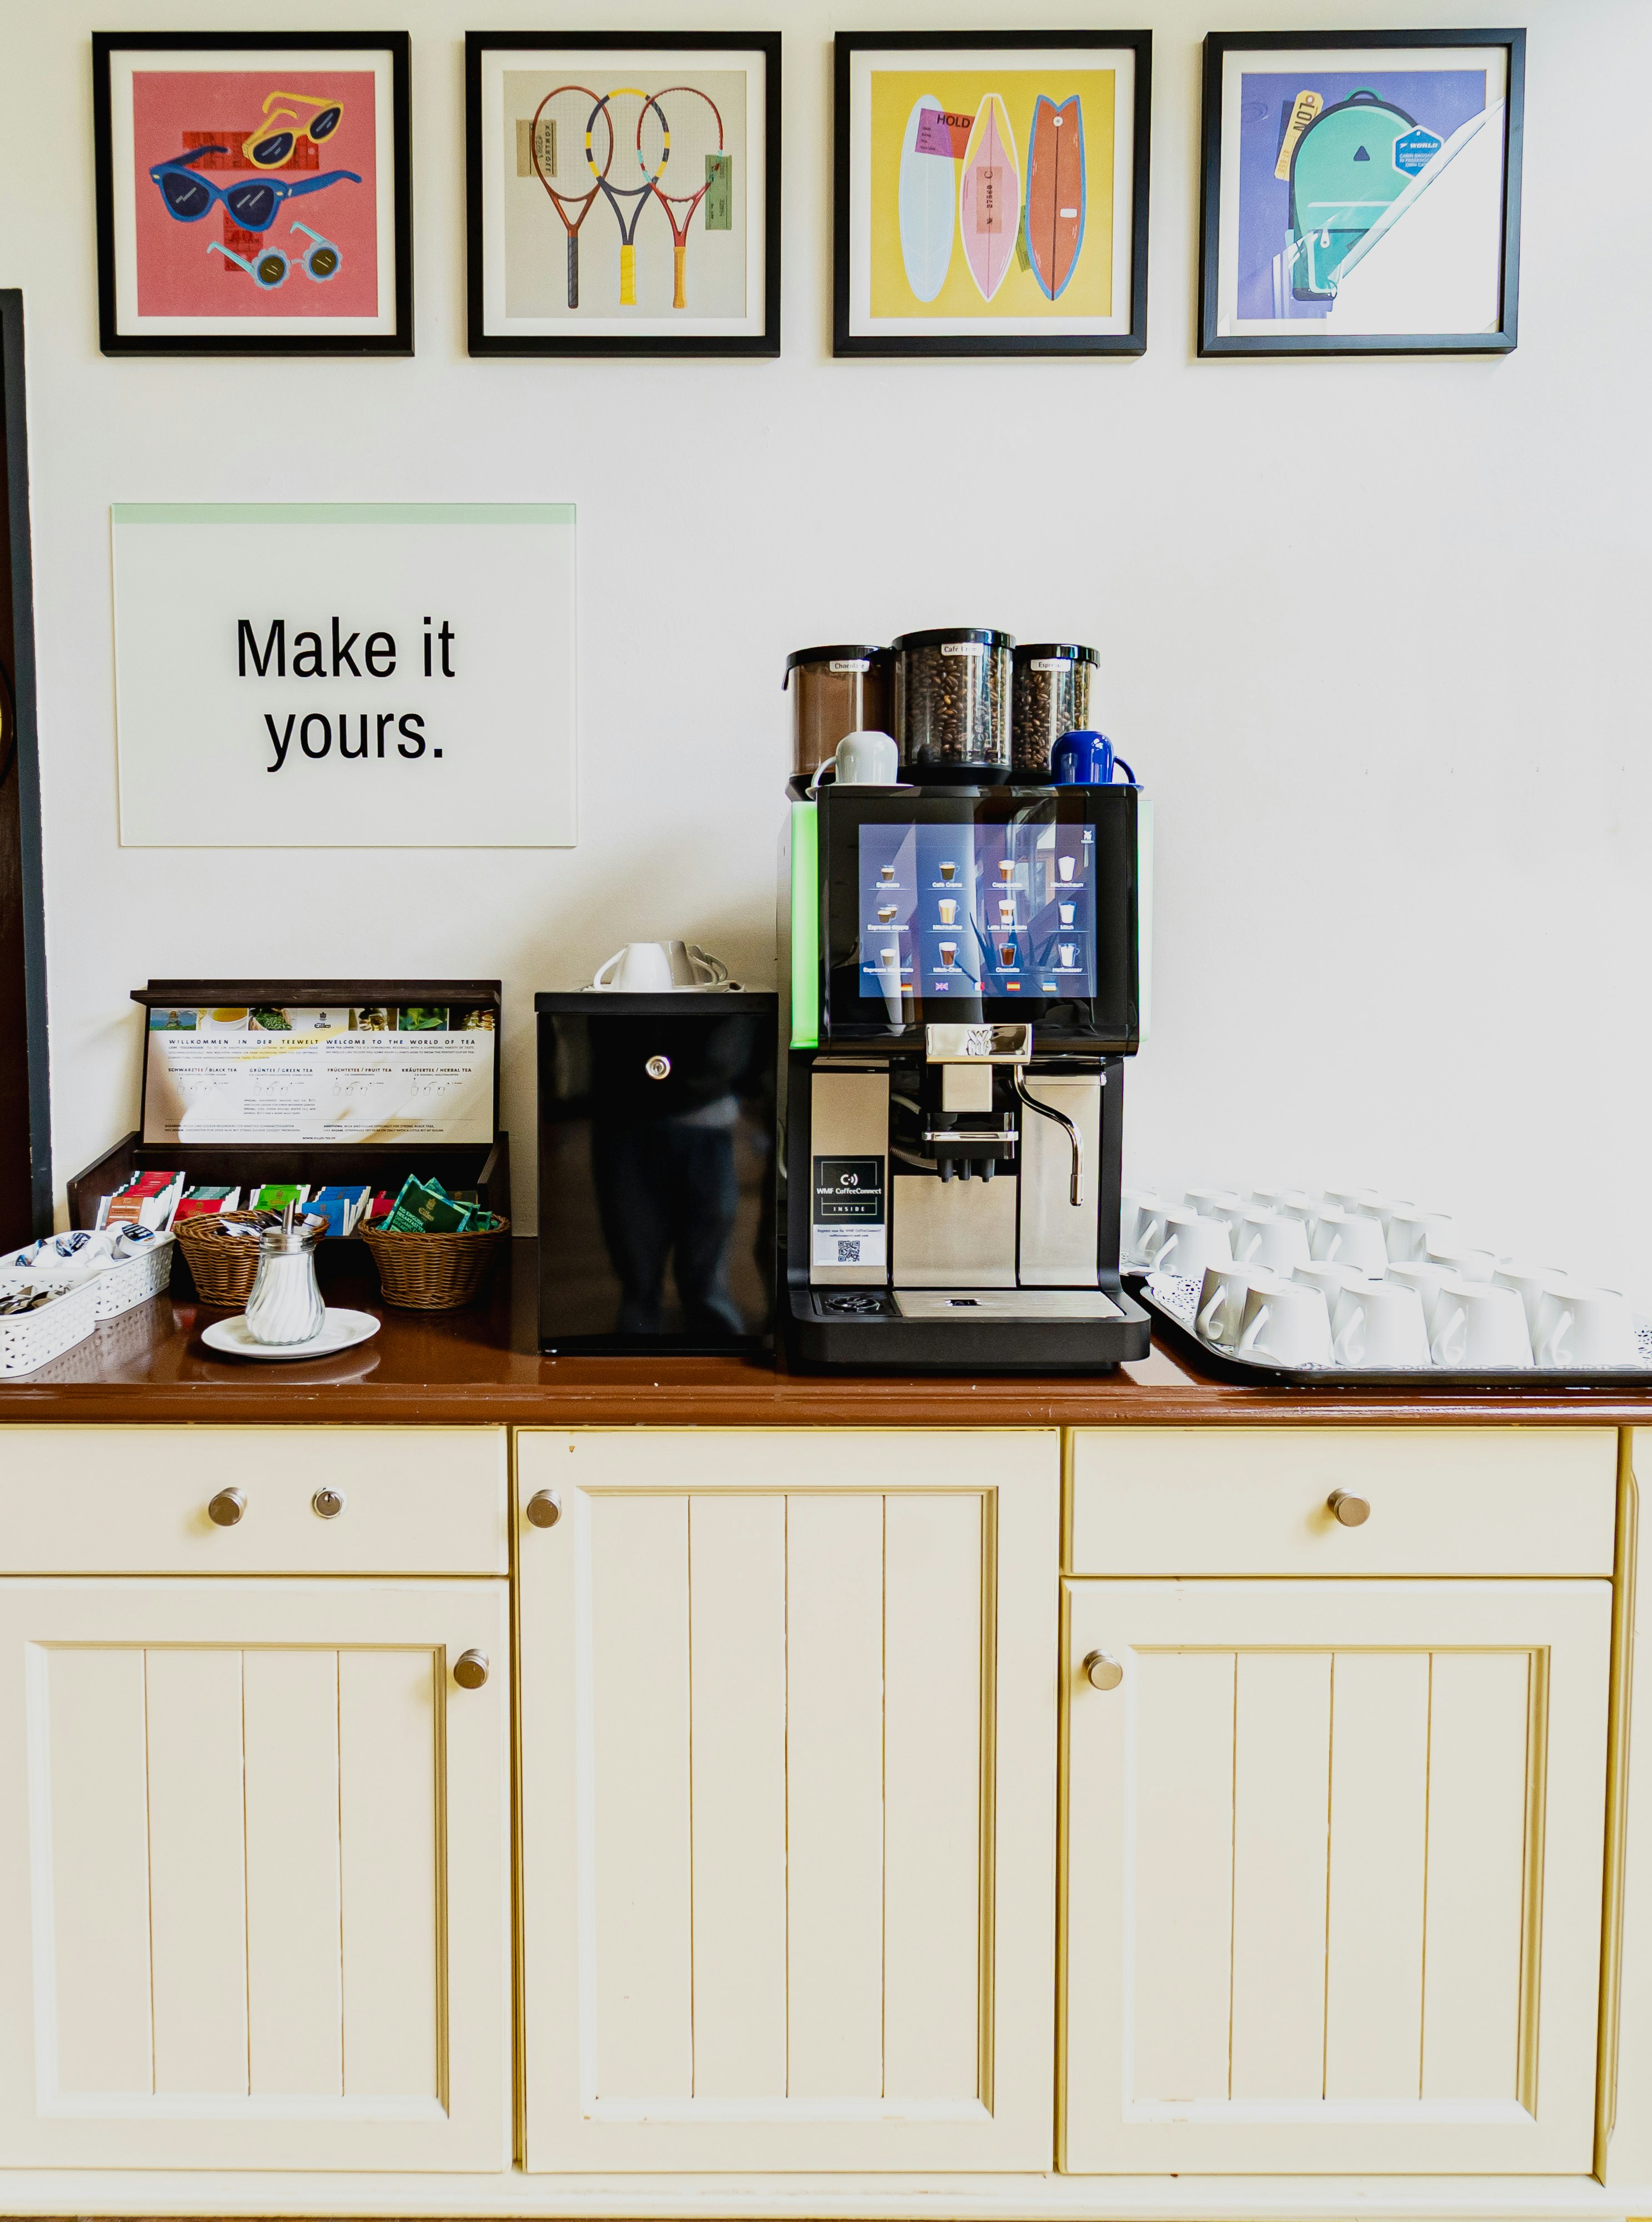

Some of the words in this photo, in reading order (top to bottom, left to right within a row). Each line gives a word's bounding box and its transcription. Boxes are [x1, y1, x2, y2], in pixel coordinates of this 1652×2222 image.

[937, 114, 970, 128] HOLD
[1293, 102, 1315, 131] LON
[237, 616, 397, 678] Make
[423, 616, 455, 678] it
[264, 713, 443, 773] yours.
[397, 1211, 418, 1228] BREAKFAST
[406, 1211, 424, 1227] ENGLISH
